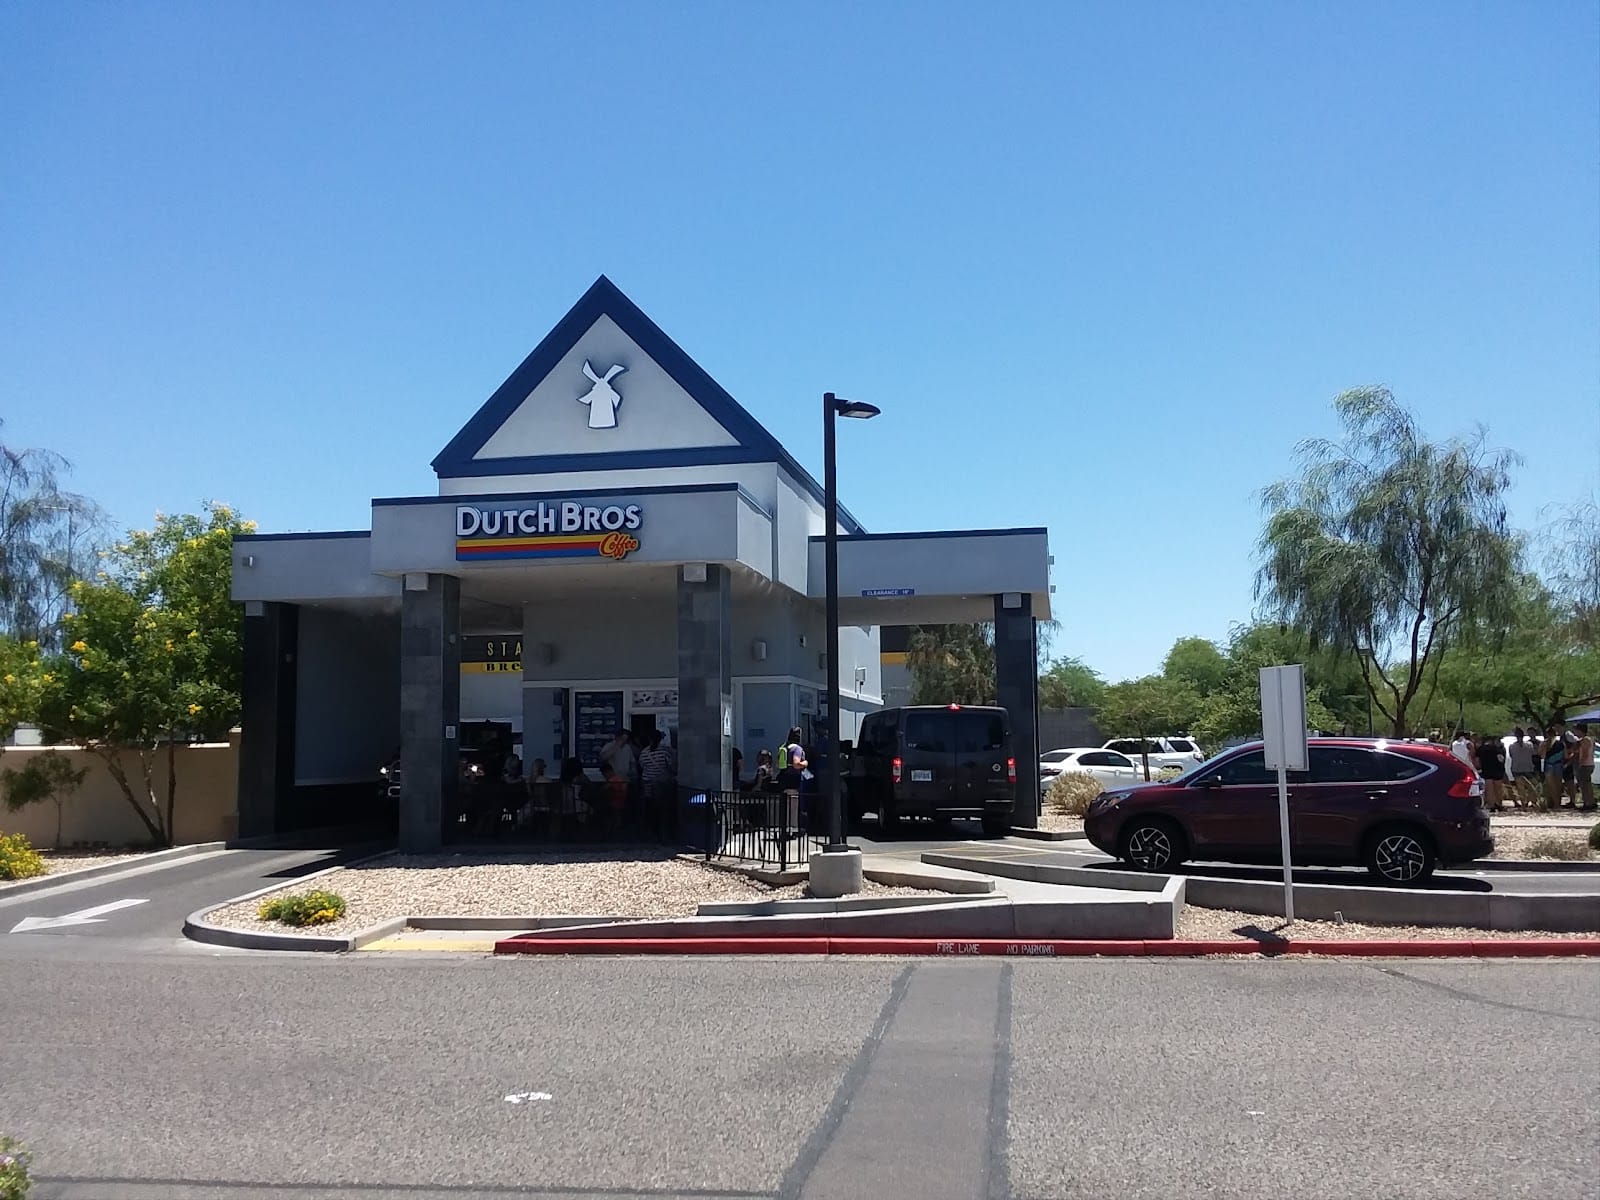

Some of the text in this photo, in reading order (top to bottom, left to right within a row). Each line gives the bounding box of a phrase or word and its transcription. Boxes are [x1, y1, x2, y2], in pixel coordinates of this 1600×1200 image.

[456, 501, 641, 536] DUTCH BROS
[936, 943, 1055, 954] FIRE LANE NO PARKING
